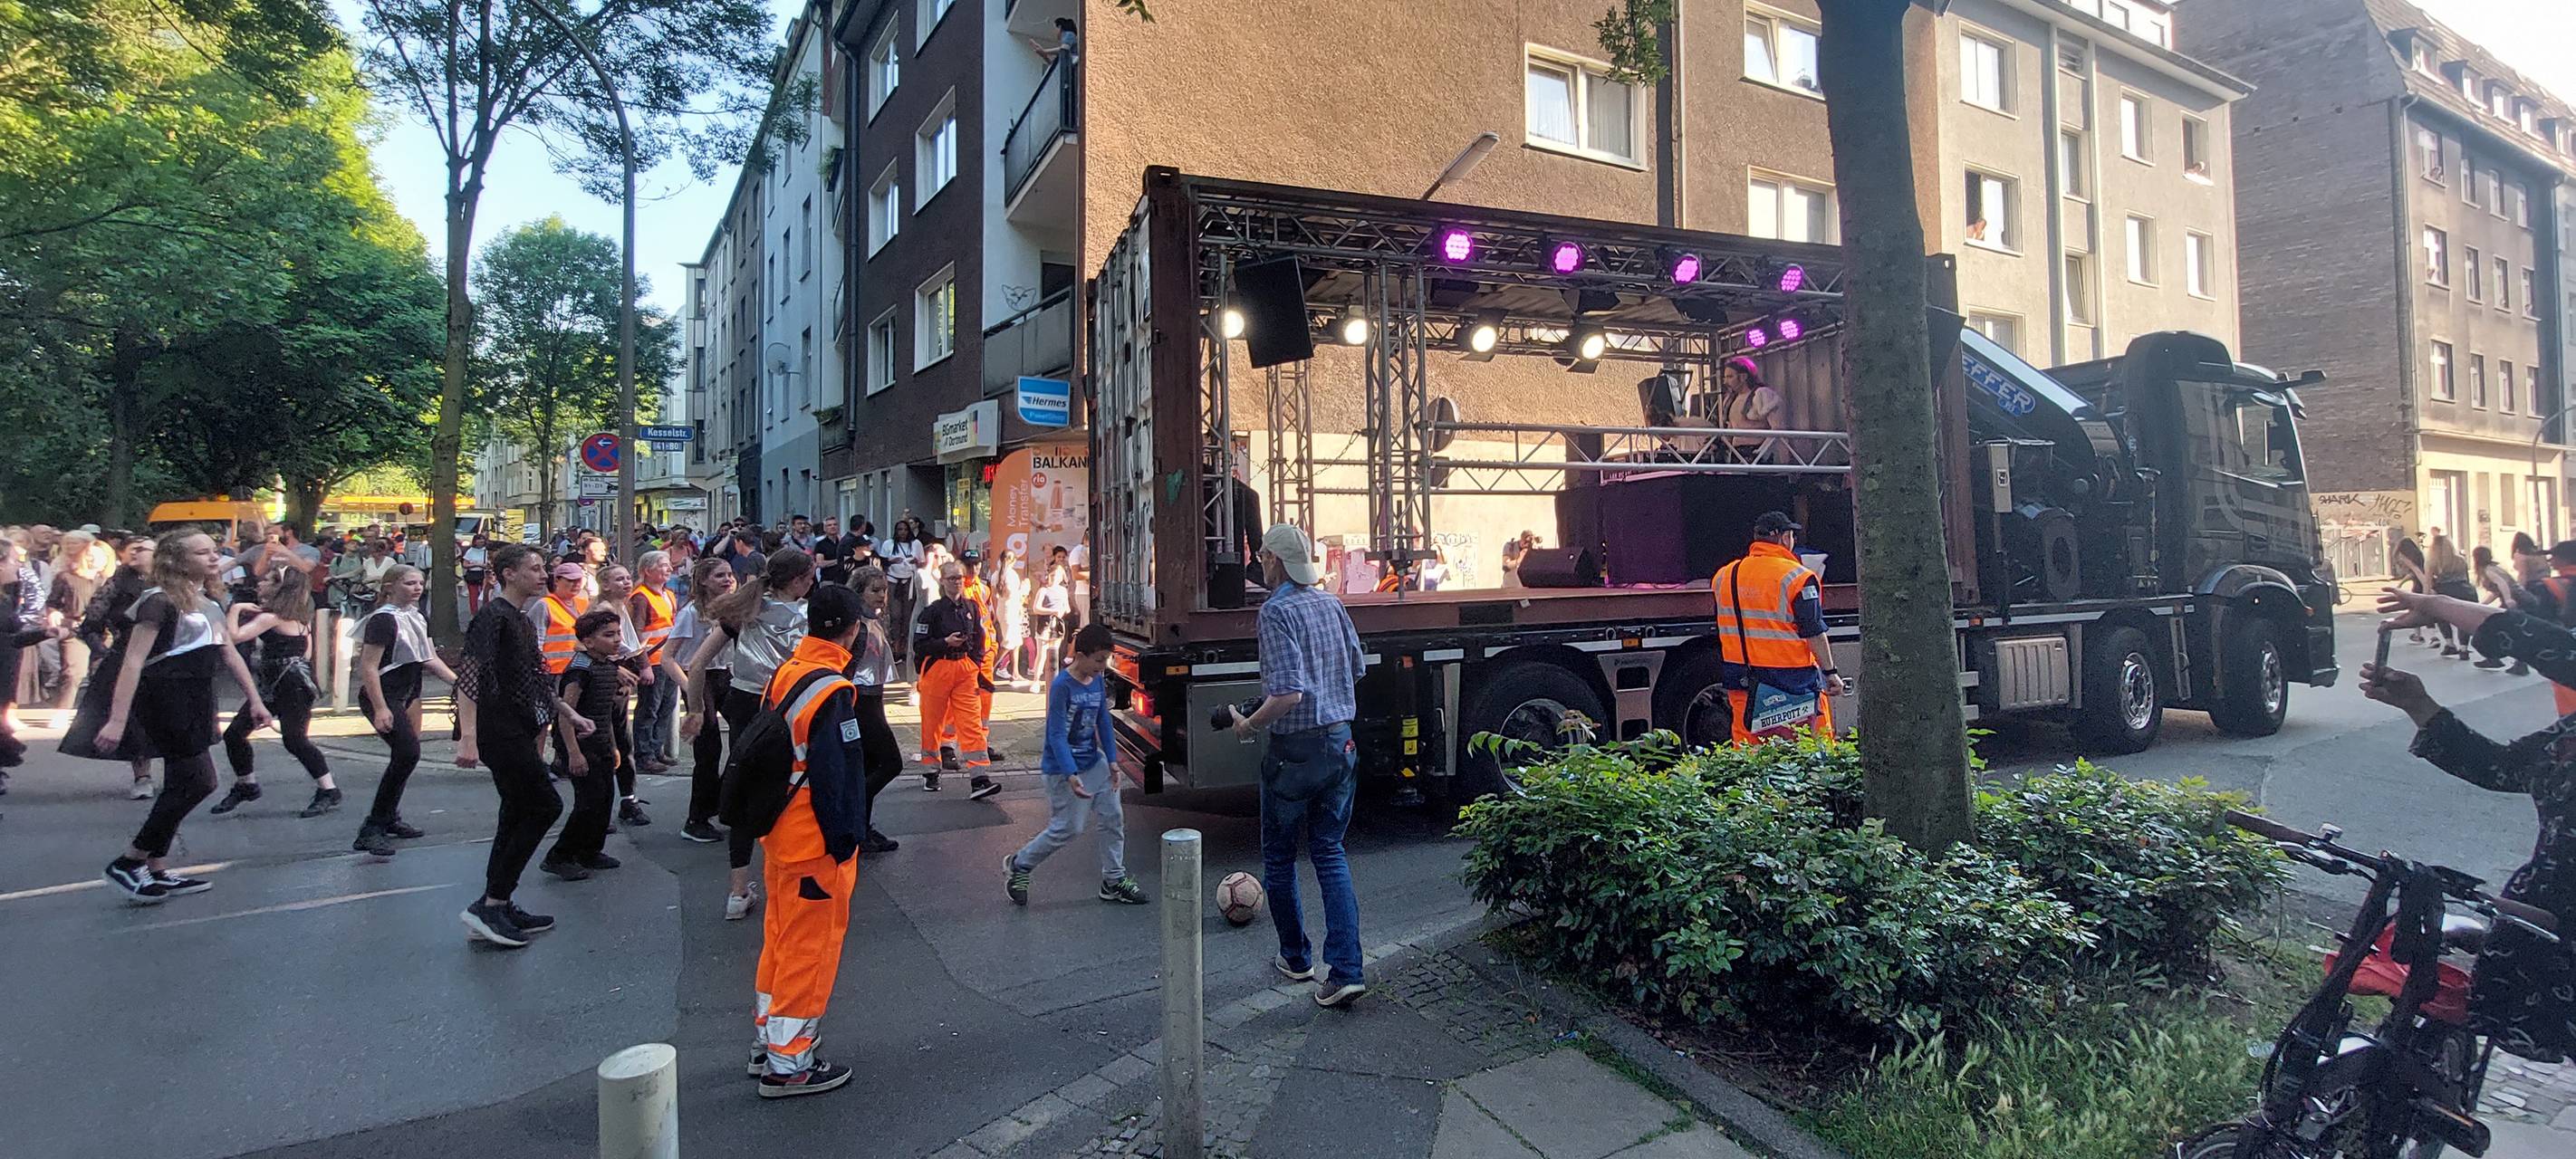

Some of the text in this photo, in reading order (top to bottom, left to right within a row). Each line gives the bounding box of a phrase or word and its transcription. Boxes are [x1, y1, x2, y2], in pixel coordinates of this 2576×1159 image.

[1033, 397, 1067, 407] Hermes
[648, 427, 687, 437] Kesselstr.
[1006, 484, 1019, 527] Money
[1018, 479, 1030, 527] Transfer
[1760, 707, 1802, 728] RUHRPOTT
